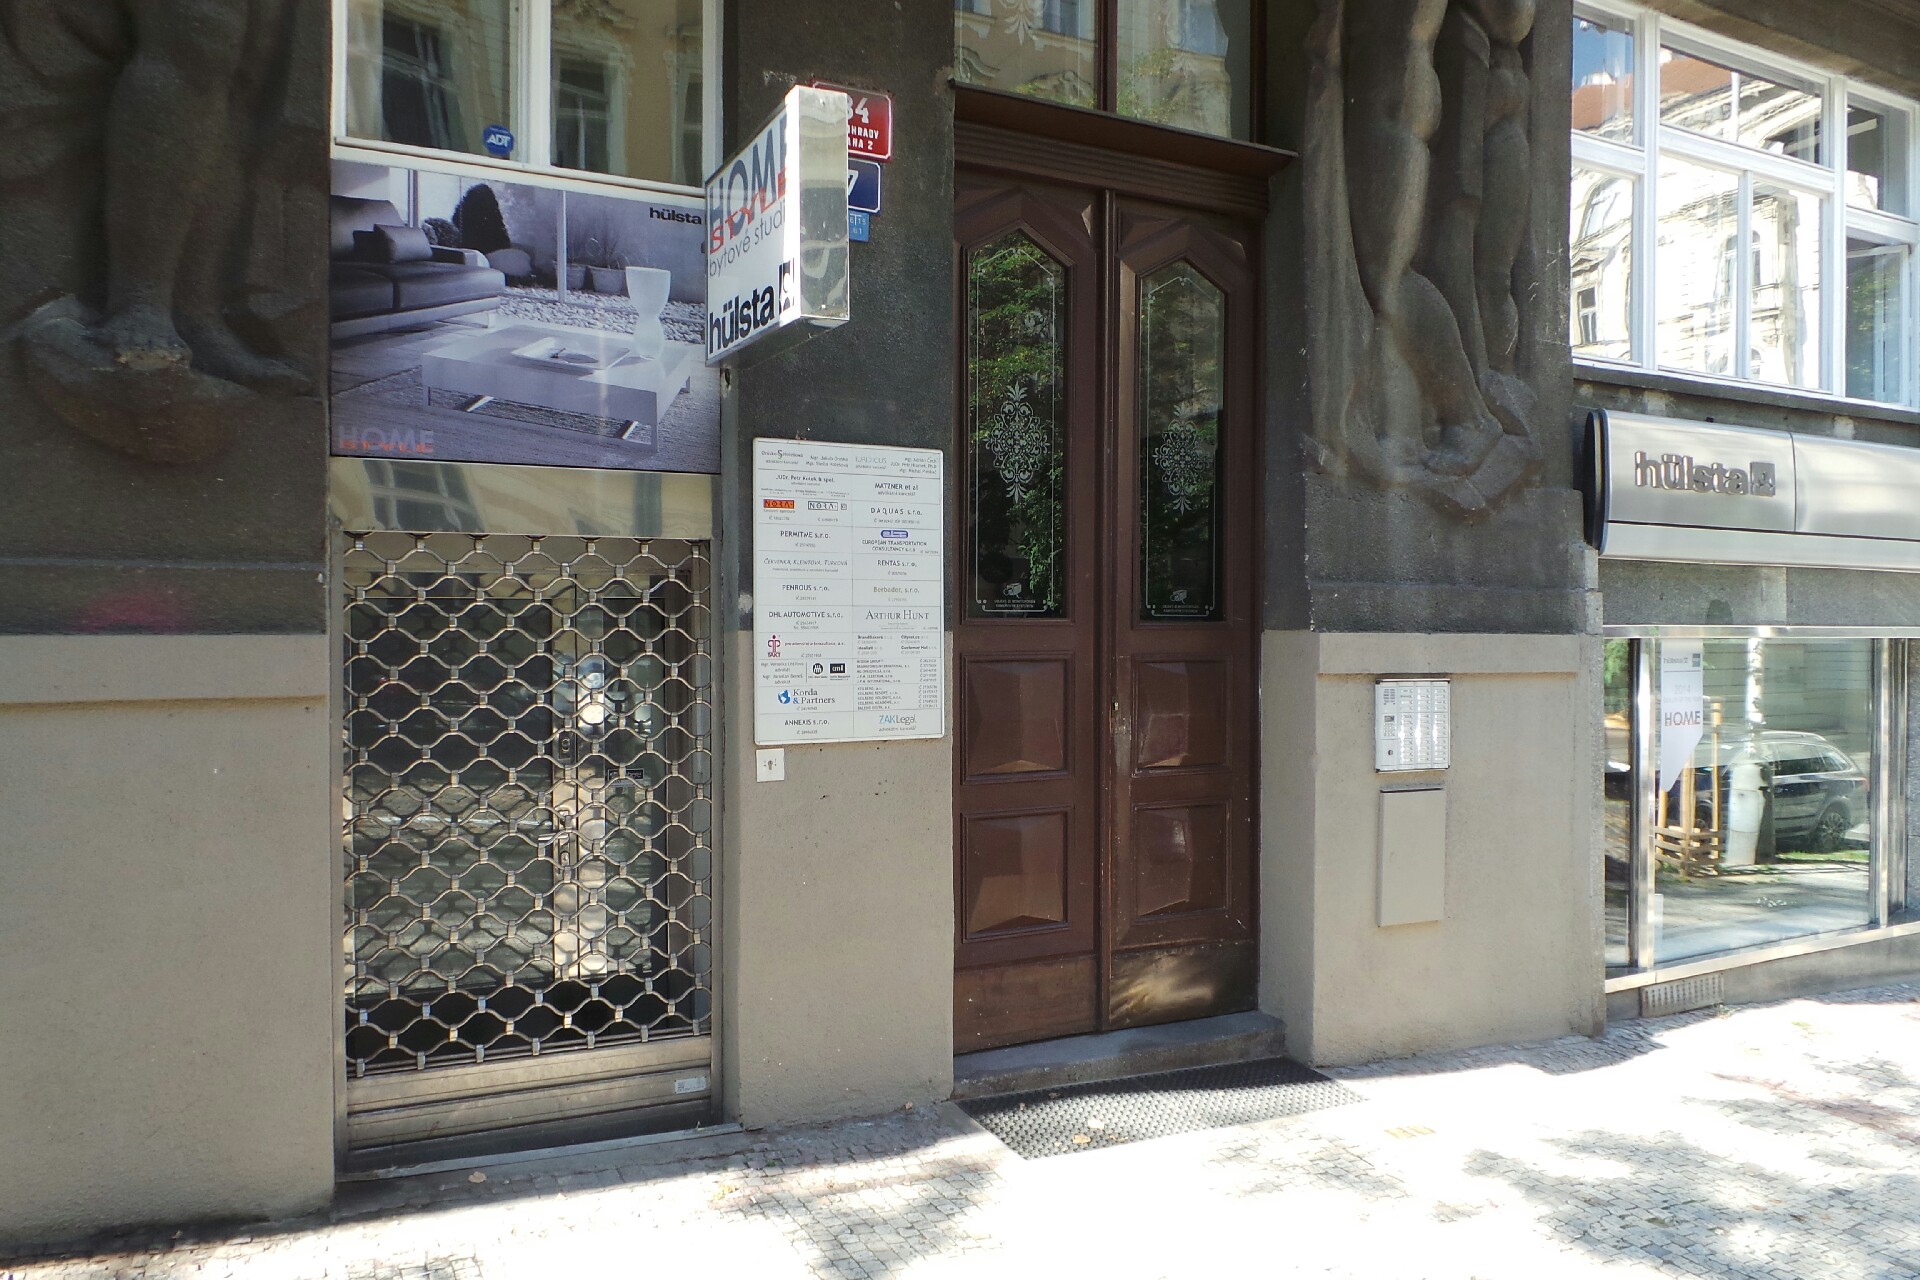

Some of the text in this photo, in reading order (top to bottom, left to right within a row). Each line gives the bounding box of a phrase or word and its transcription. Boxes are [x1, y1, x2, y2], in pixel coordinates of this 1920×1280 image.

[486, 133, 511, 147] ADT
[868, 140, 874, 151] 2
[649, 206, 702, 225] hülsta
[709, 200, 787, 277] bytové studi
[709, 284, 774, 353] hülsta
[1635, 451, 1748, 495] hülsta
[874, 482, 902, 490] MATZNER
[793, 688, 818, 696] Korda
[801, 696, 835, 704] Partners
[1664, 710, 1701, 727] HOME
